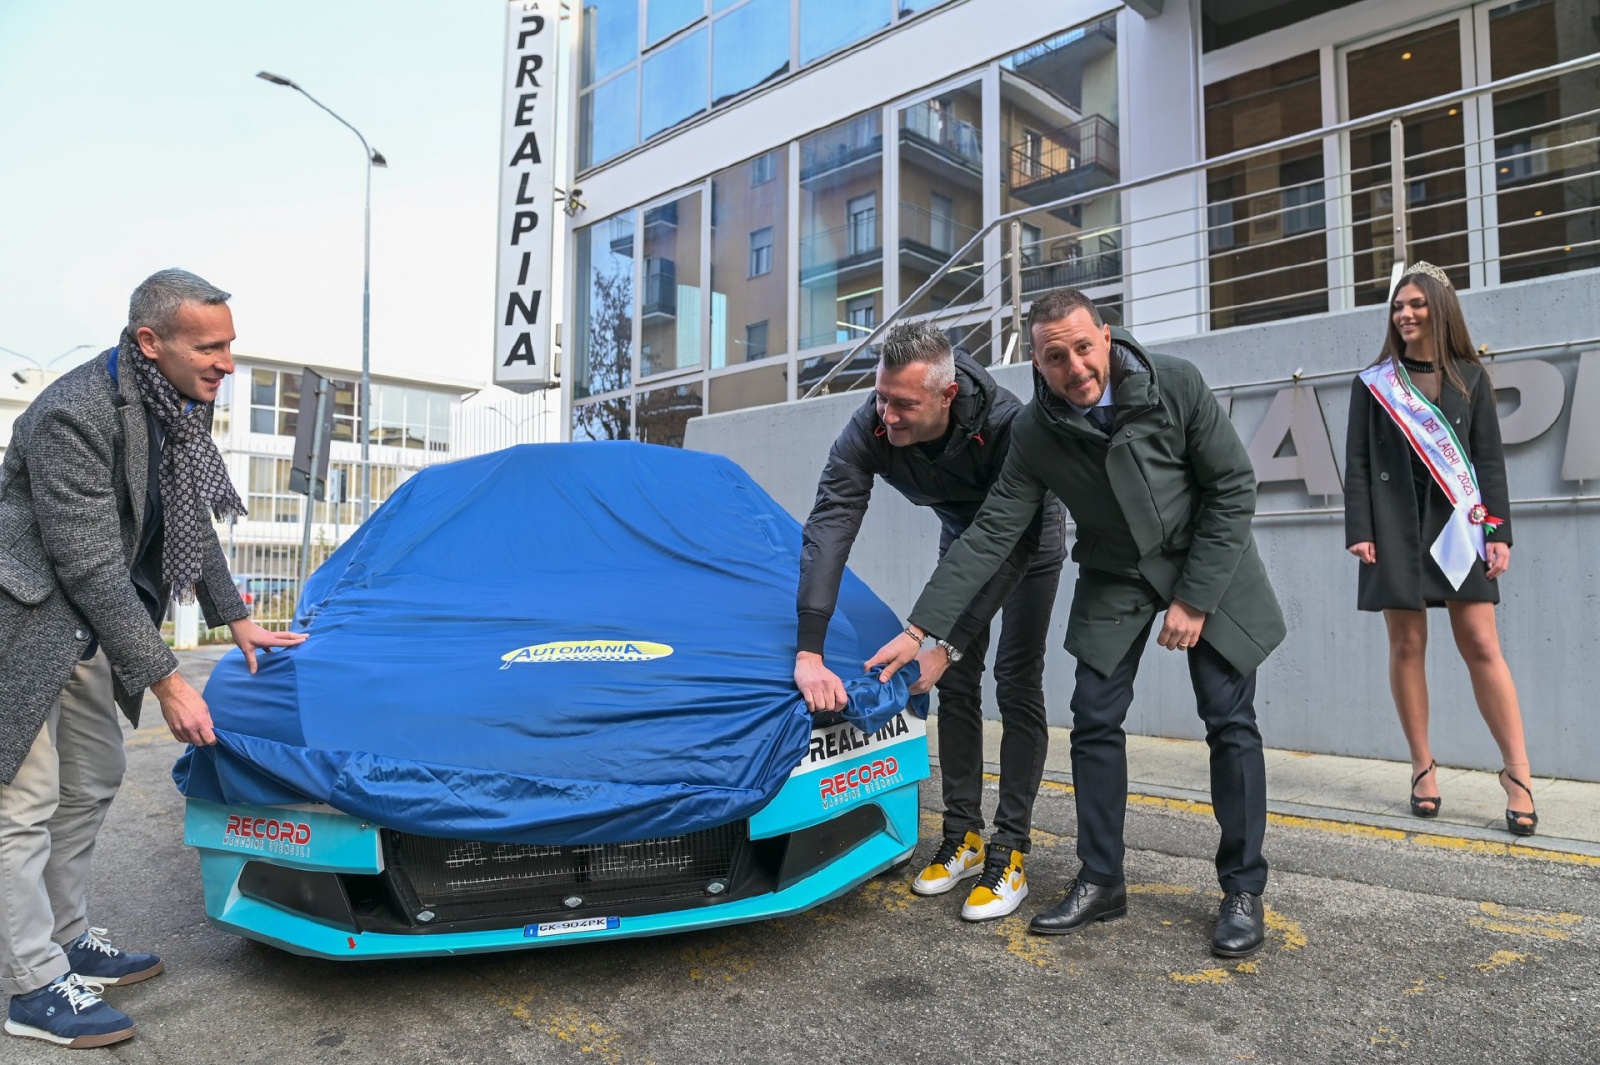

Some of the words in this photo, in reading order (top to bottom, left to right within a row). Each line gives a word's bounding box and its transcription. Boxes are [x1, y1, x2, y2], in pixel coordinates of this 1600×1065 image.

[521, 2, 539, 11] LA
[502, 15, 545, 367] PREALPINA
[1421, 417, 1440, 435] DEI
[1435, 436, 1461, 466] LAGHI
[1457, 471, 1475, 497] 2023
[511, 643, 642, 660] AUTOMANIA
[820, 756, 899, 799] RECORD
[225, 814, 312, 845] RECORD
